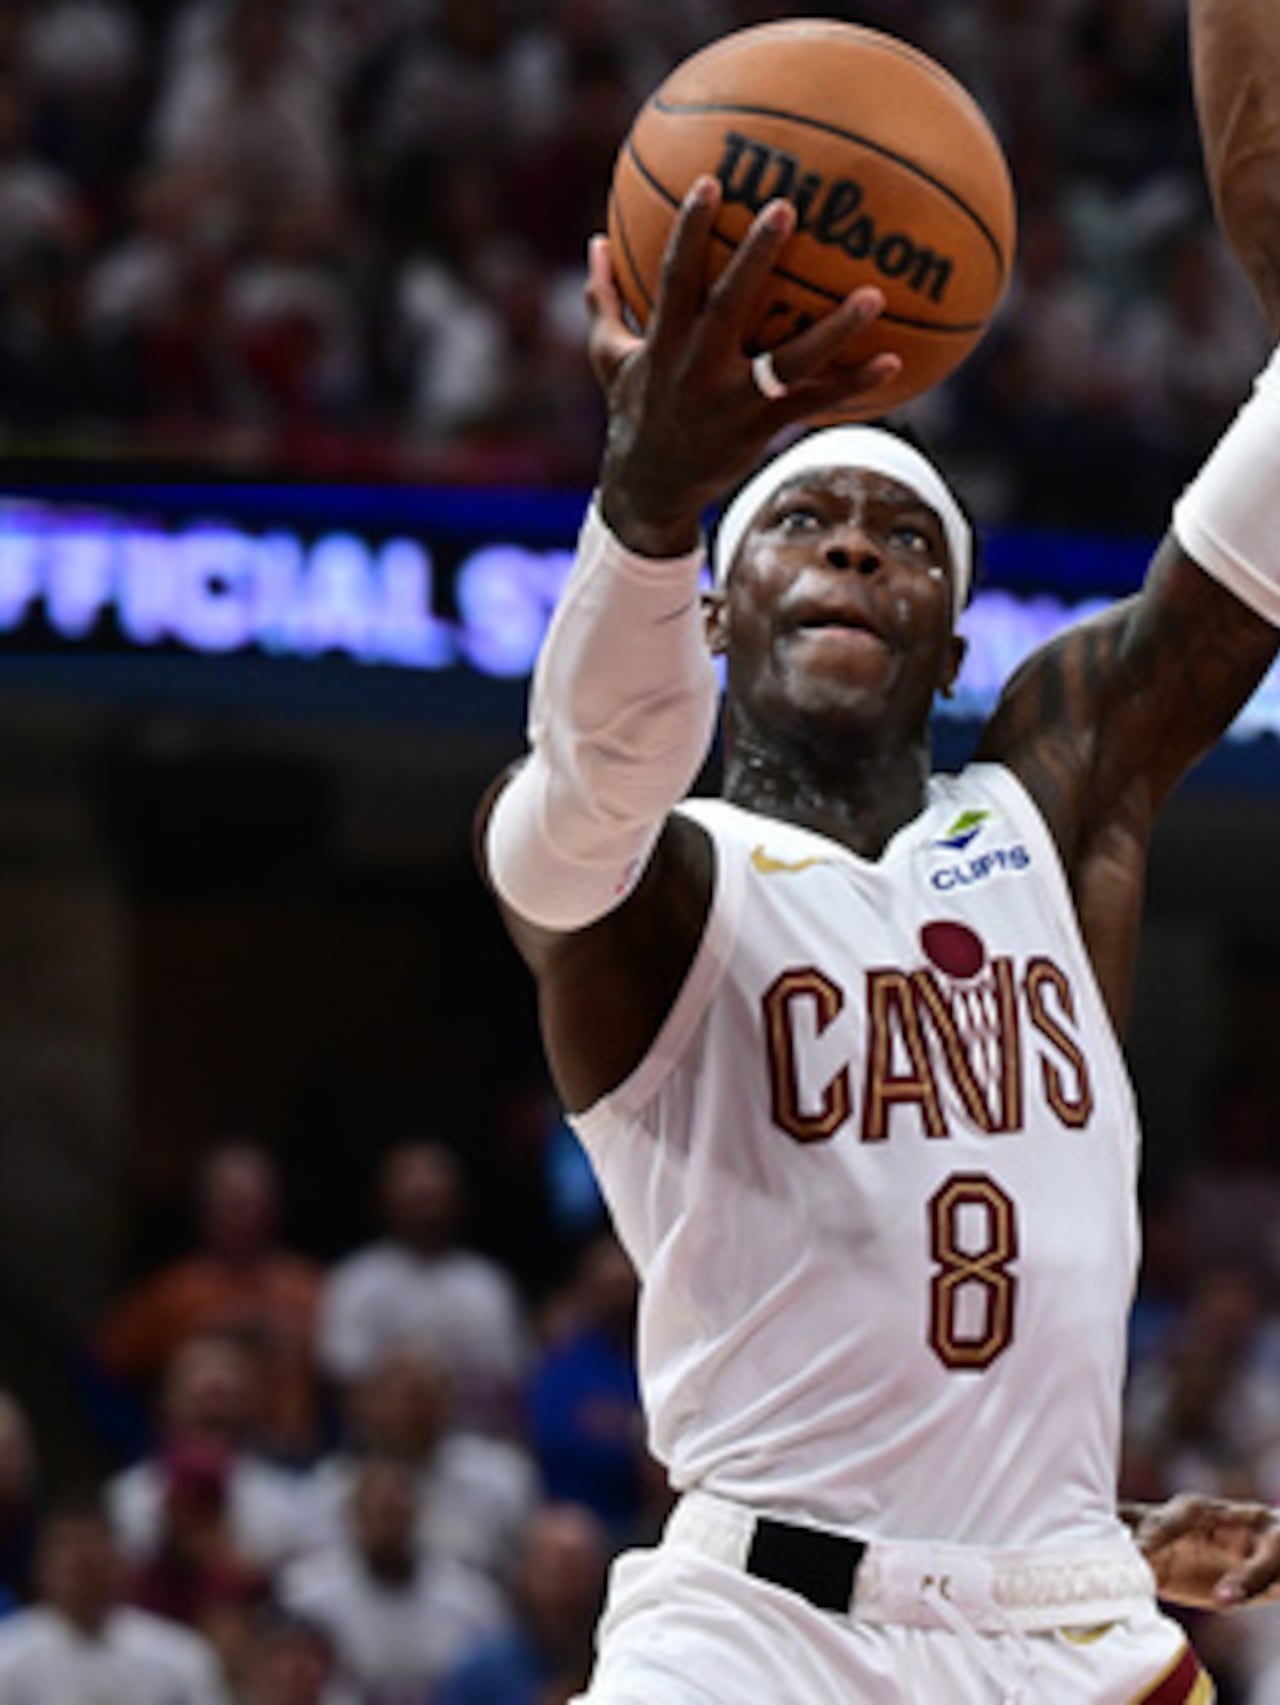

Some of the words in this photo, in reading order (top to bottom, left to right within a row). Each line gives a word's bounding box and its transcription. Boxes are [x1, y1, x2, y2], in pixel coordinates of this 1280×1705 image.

[716, 130, 955, 304] Wilson
[762, 956, 1094, 1144] CAVS
[927, 1171, 1019, 1372] 8
